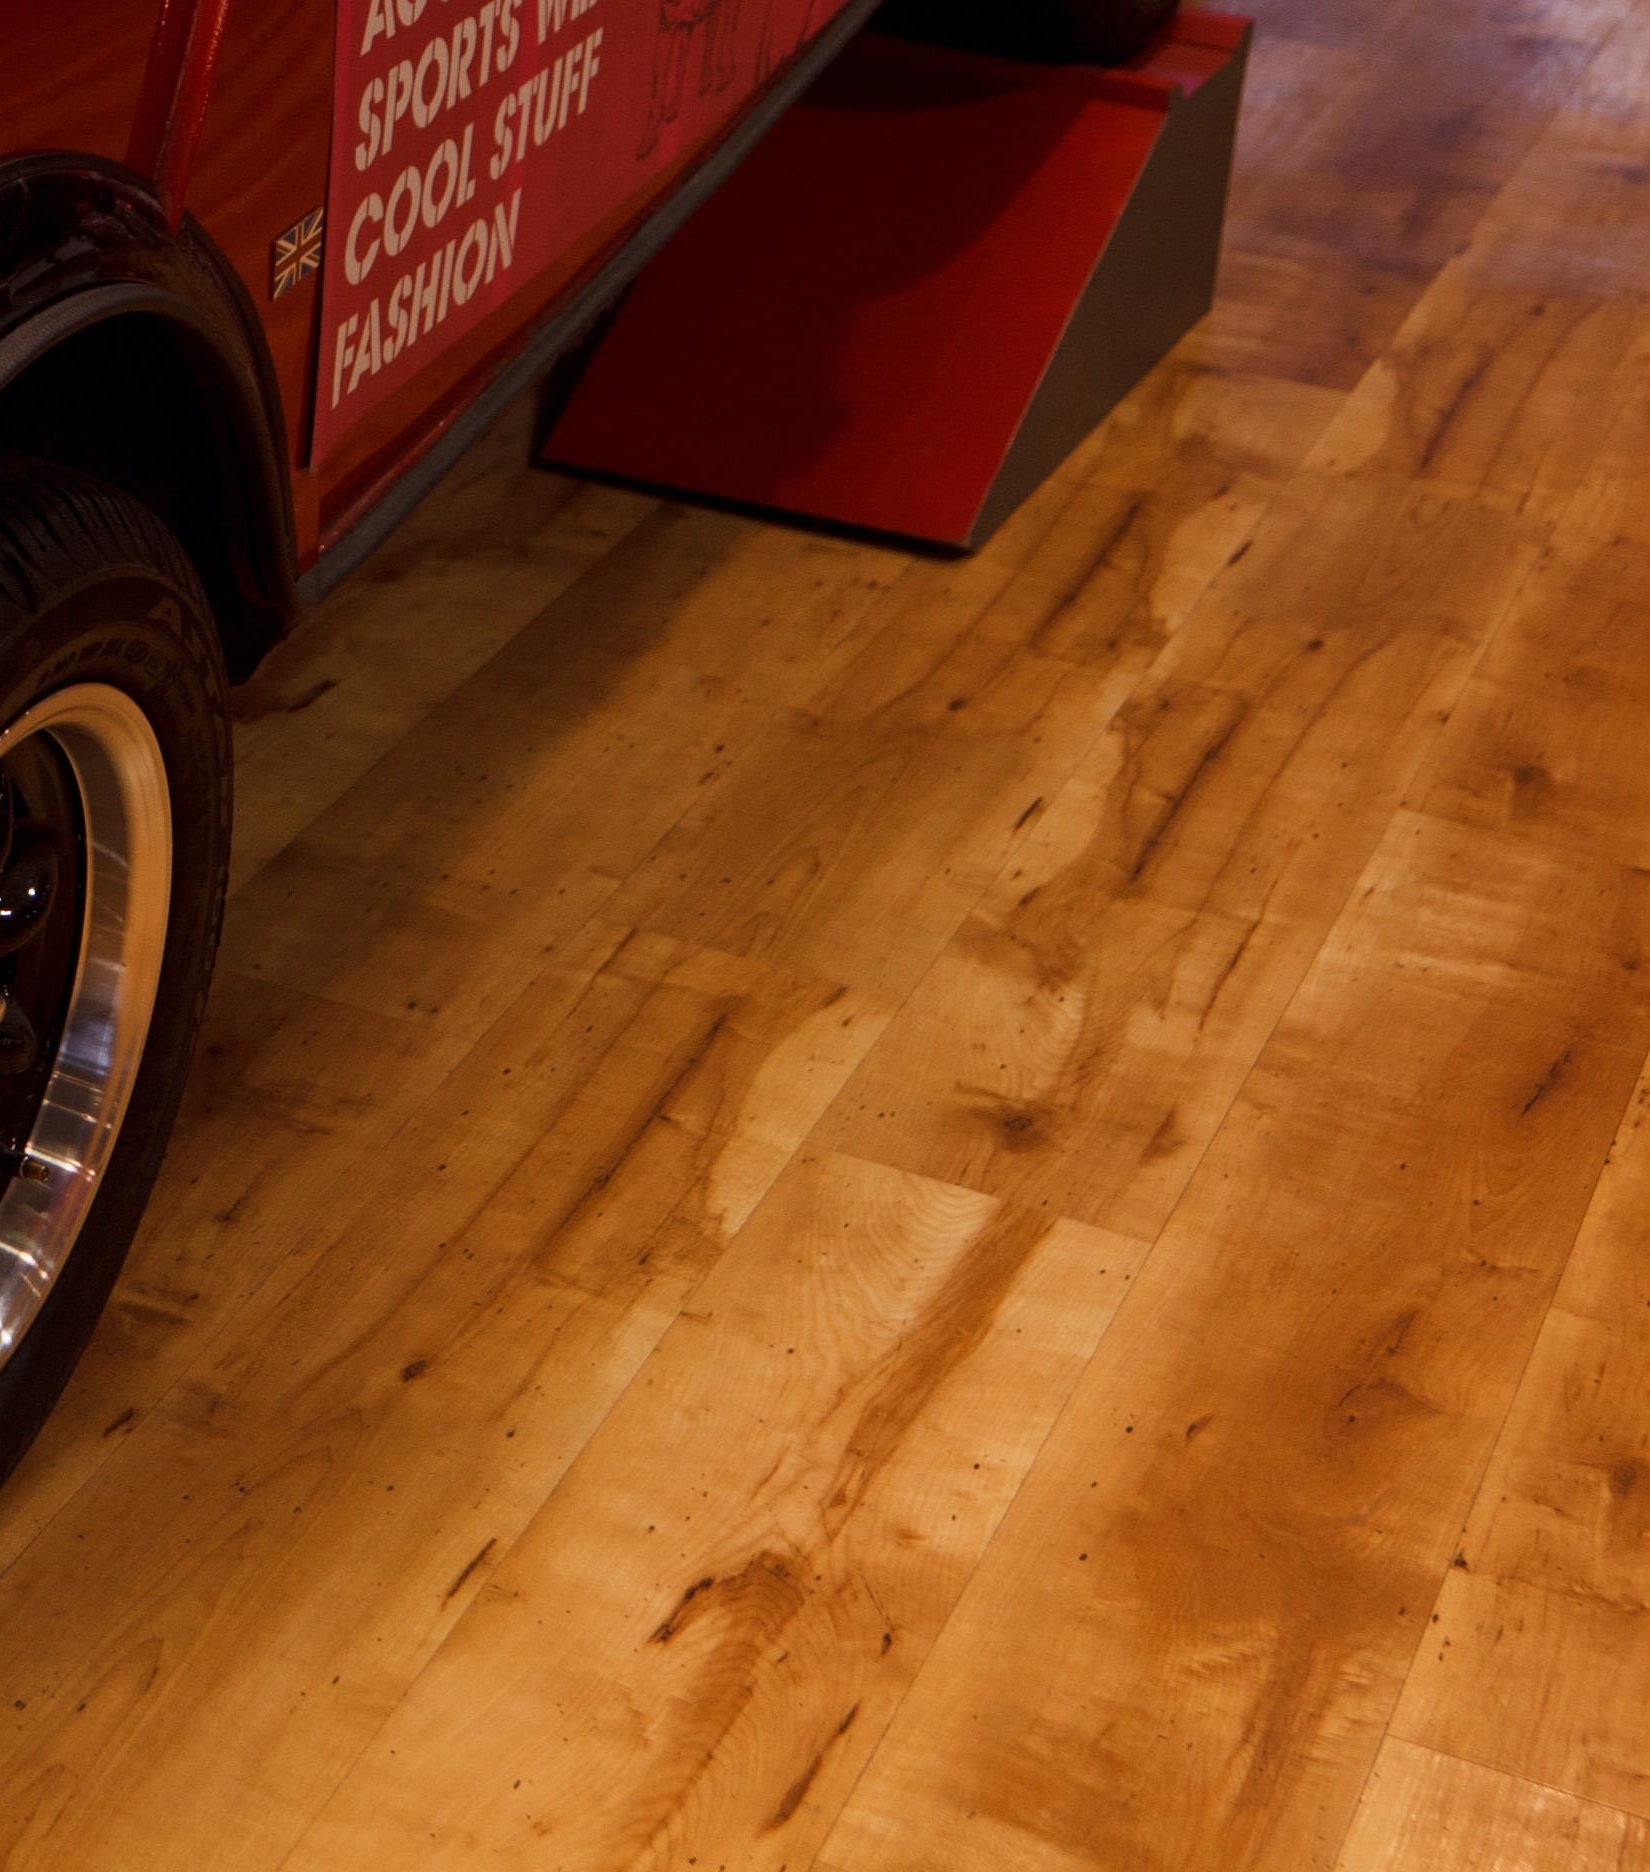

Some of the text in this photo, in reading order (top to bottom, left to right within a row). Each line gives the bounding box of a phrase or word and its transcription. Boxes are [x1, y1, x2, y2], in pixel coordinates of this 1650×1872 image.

[344, 27, 603, 287] COOL STUFF
[331, 189, 522, 410] FASHION
